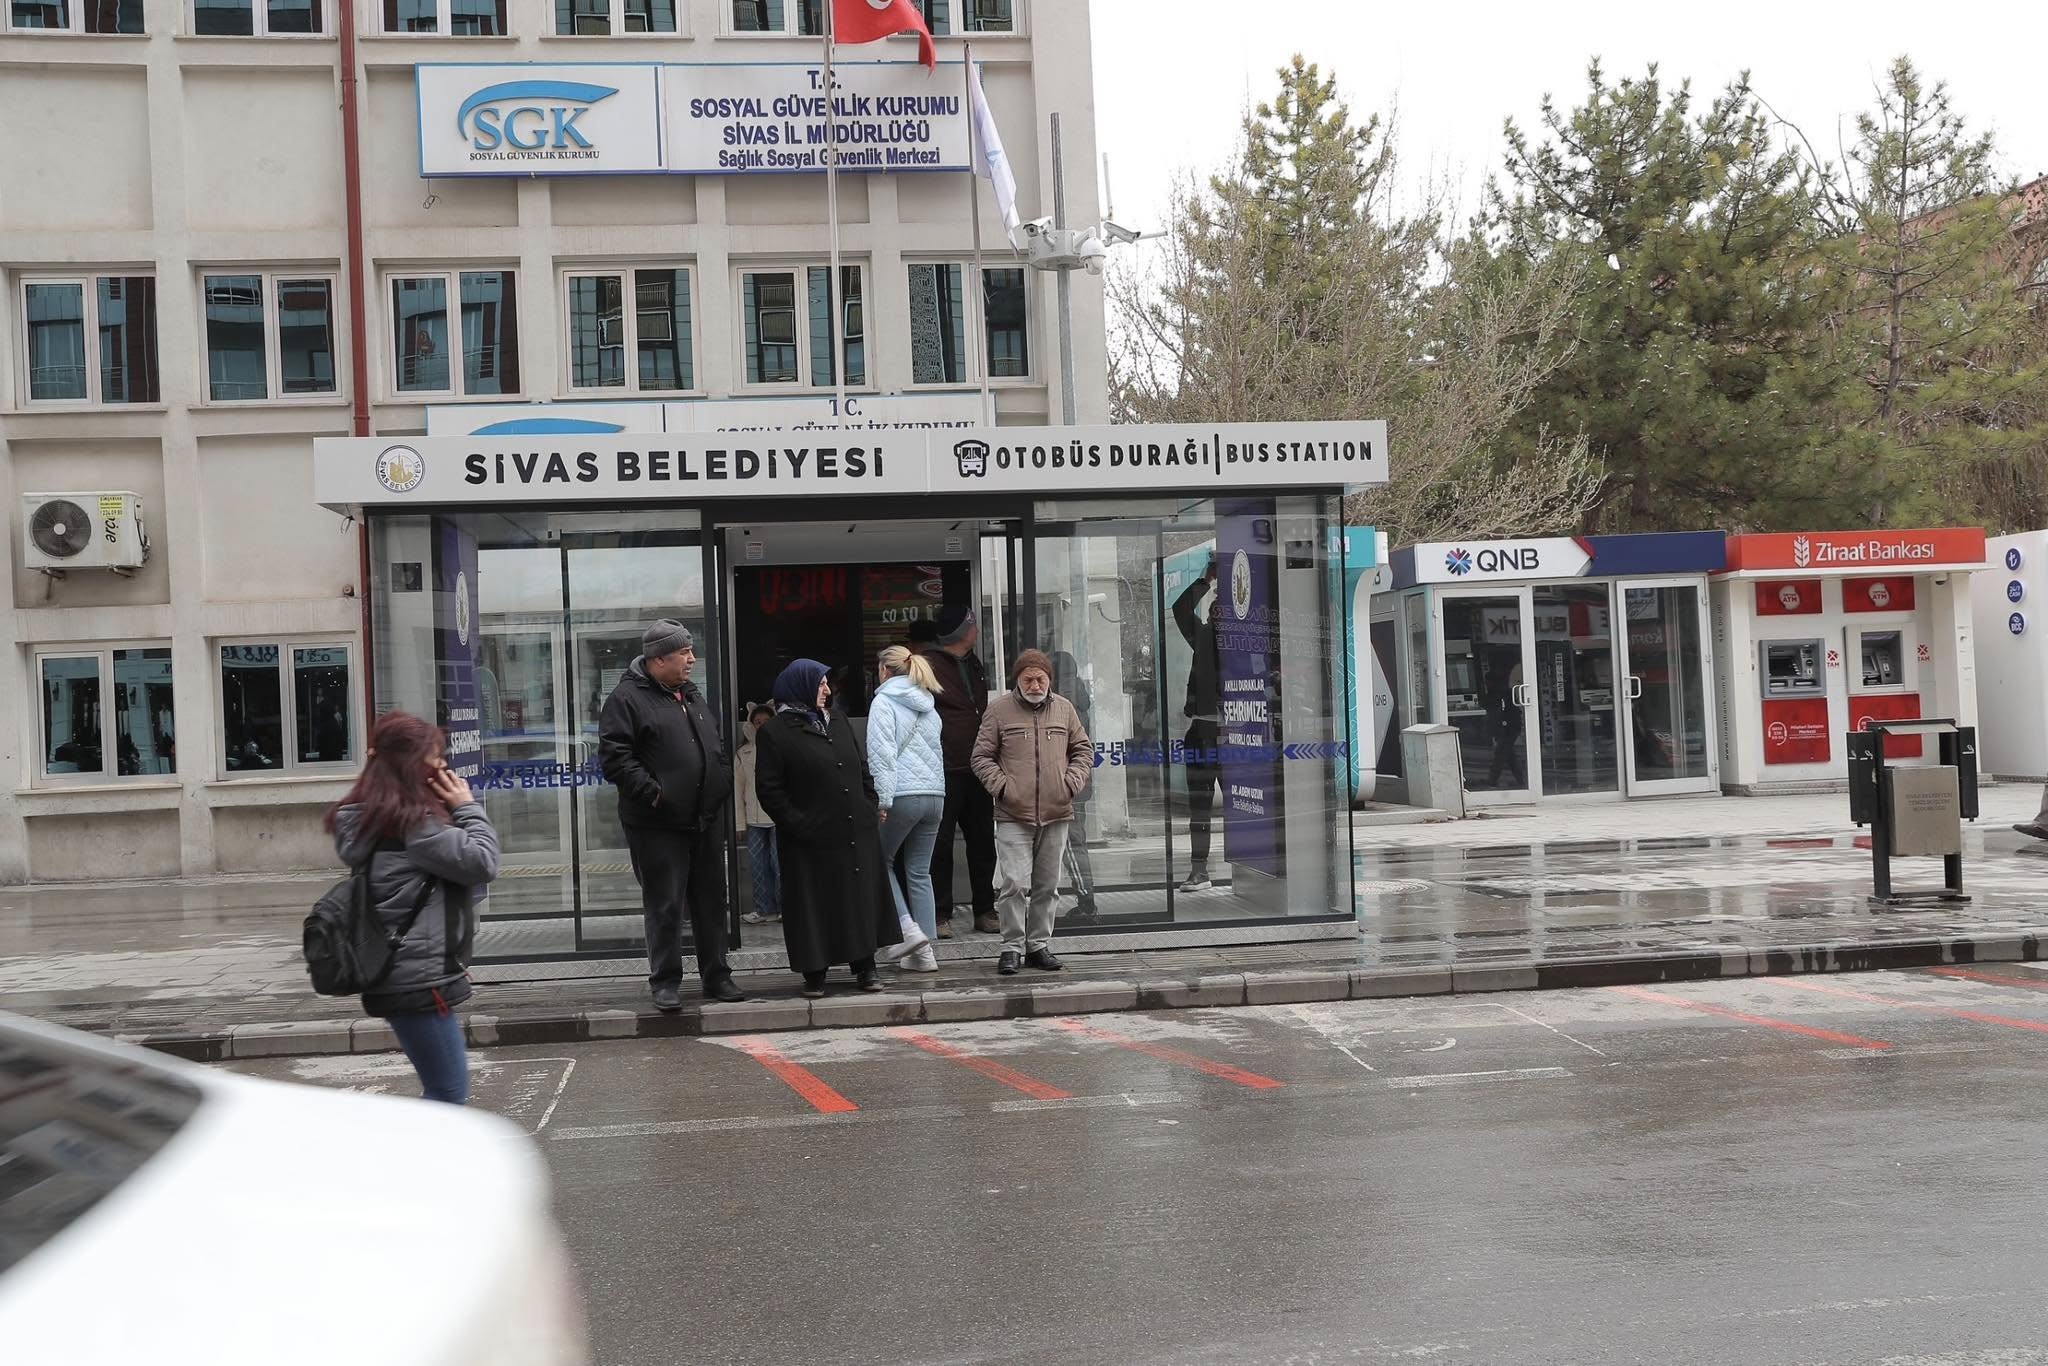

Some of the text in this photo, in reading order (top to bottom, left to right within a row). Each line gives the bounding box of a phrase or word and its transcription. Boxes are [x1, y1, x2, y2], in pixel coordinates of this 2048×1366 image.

[807, 70, 842, 89] T.C.
[690, 93, 959, 118] SOSYAL GÜVENLİK KURUMU
[473, 106, 594, 150] SGK
[723, 120, 930, 145] SİVAS İL MÜDÜRLÜĞÜ
[469, 150, 600, 161] SOSYAL GÜVENLİK KURUMU
[718, 146, 940, 170] Sağlık Sosyal Güvenlik Merkezi
[996, 438, 1209, 469] OTOBÜS DURAĞI
[1226, 441, 1372, 463] BUS STATION
[464, 448, 883, 485] SİVAS BELEDİYESİ
[1476, 548, 1540, 573] QNB
[1815, 540, 1935, 561] Ziraat Bankası
